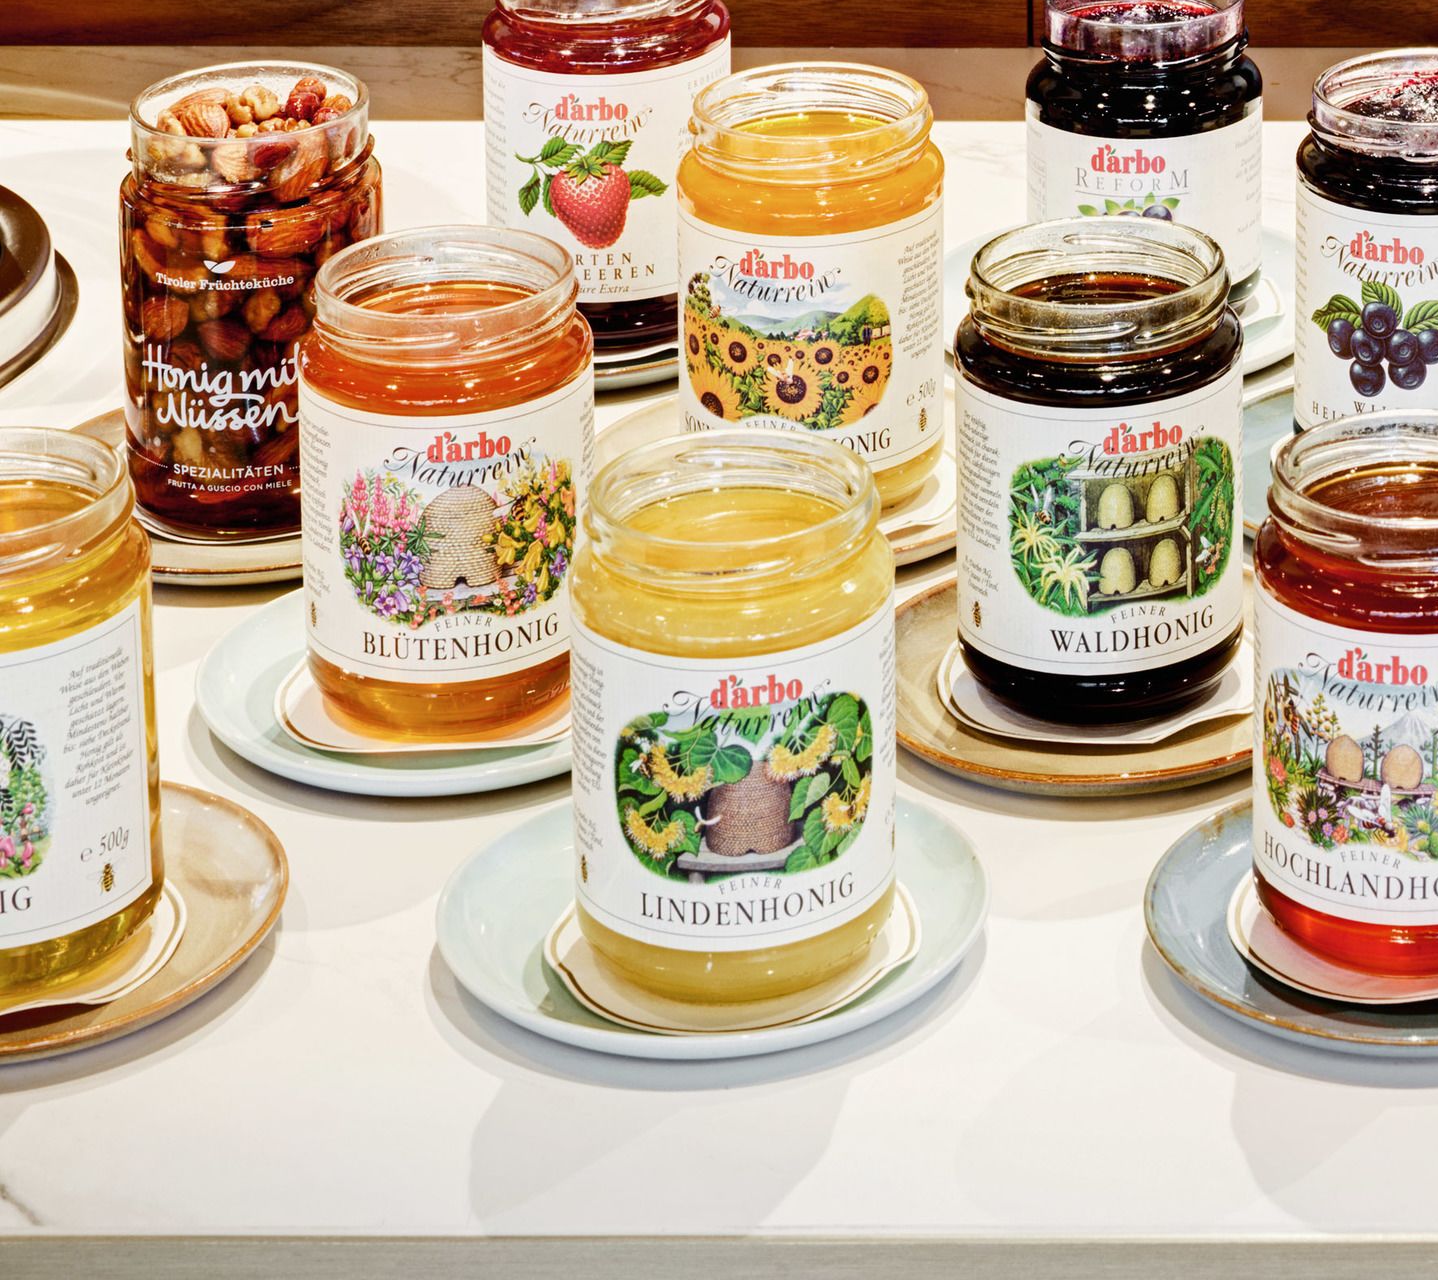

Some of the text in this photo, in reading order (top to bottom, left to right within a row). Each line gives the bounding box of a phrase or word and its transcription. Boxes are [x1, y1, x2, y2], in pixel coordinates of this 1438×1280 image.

[522, 102, 653, 144] Naturrein
[1075, 167, 1189, 192] REFORM
[575, 252, 632, 266] RTEN
[583, 264, 655, 281] EEREN
[156, 272, 294, 290] Tiroler Früchteküche
[709, 255, 841, 303] Naturrein
[142, 341, 300, 407] Honig mit
[157, 393, 300, 431] Nüssen
[384, 437, 537, 488] Naturrein
[1067, 425, 1205, 479] Naturrein
[167, 478, 293, 493] FRUTTA A GUSCIO CON MIELE
[173, 463, 284, 479] SPEZIALITÄTEN
[434, 615, 493, 633] FEINER
[1050, 604, 1214, 654] WALDHONIG
[1110, 605, 1167, 624] FEINER
[363, 612, 559, 661] BLÜTENHONIG
[663, 678, 831, 736] Naturrein
[98, 826, 129, 857] 500g
[1340, 850, 1401, 870] FEINER
[641, 872, 854, 926] LINDENHONIG
[719, 876, 782, 895] FEINER
